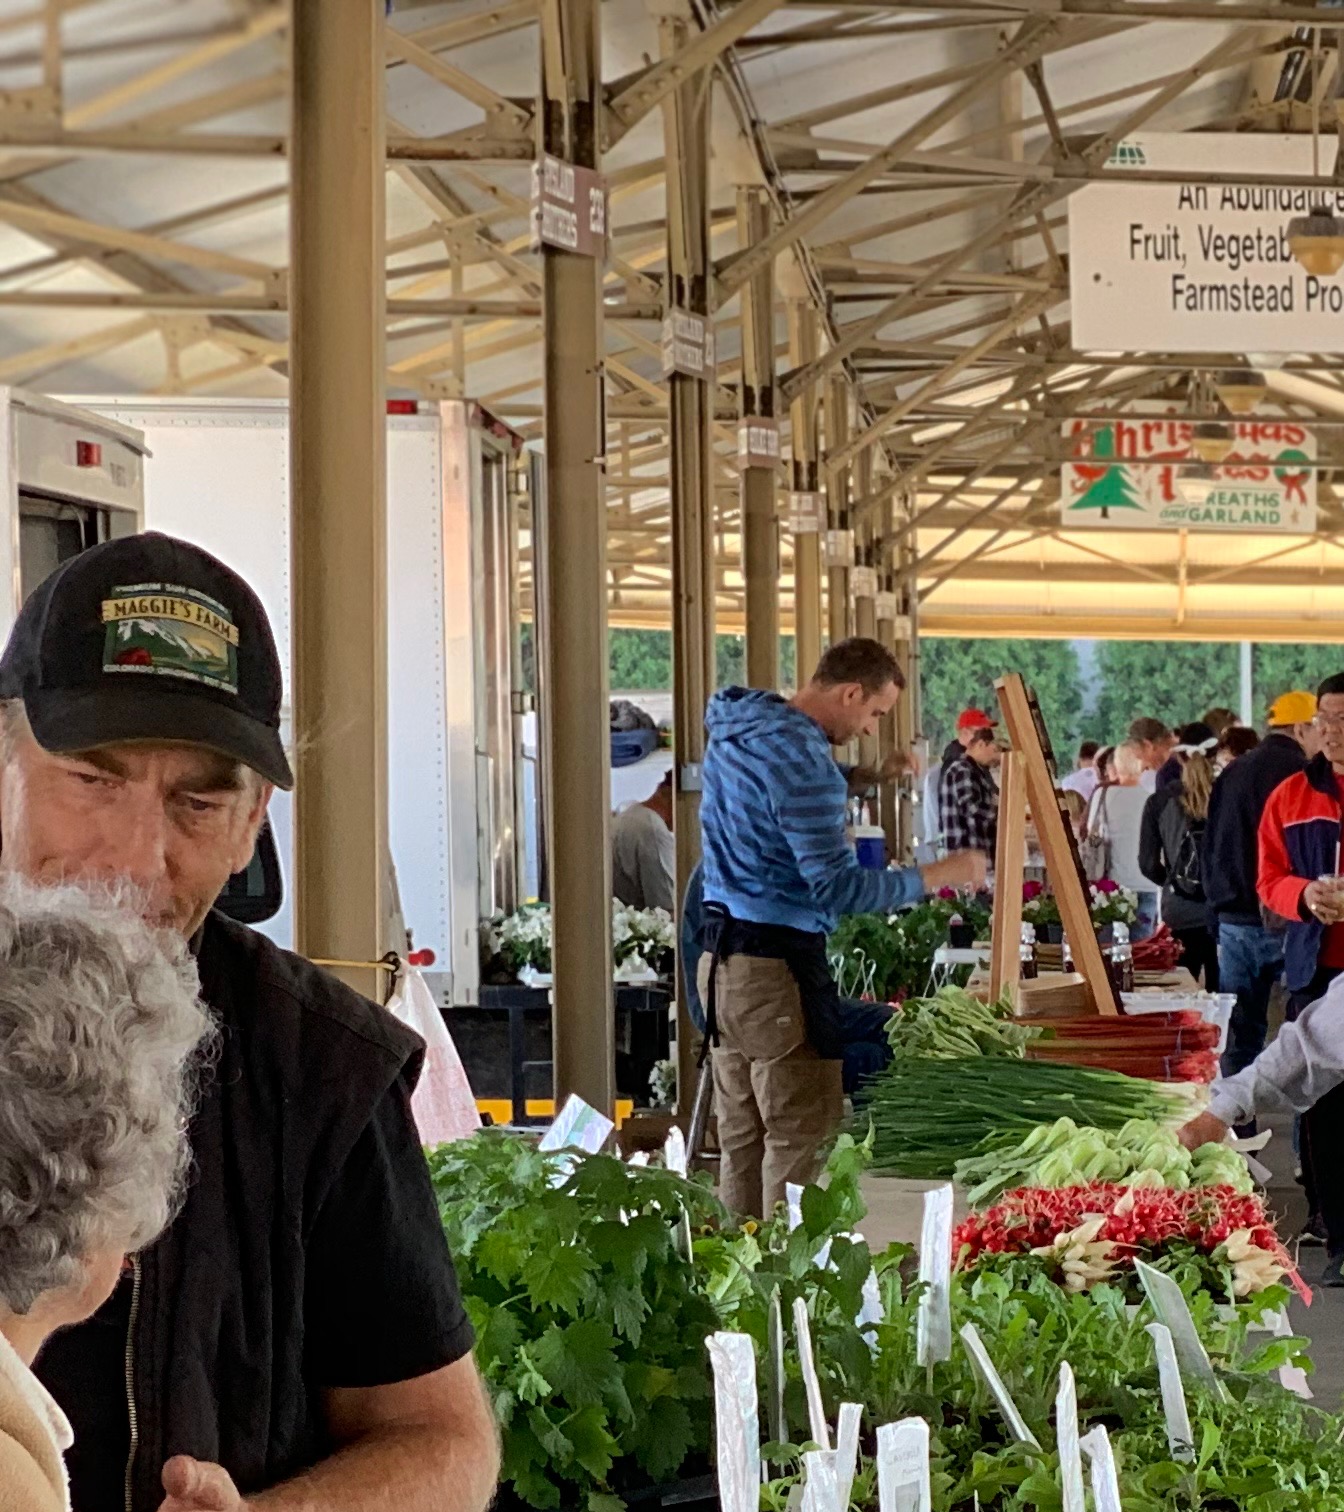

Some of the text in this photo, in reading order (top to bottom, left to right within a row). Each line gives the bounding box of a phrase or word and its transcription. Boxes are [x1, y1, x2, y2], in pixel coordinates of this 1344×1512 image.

[1129, 223, 1187, 267] Fruit,
[1197, 224, 1299, 271] Vegetab
[1171, 274, 1294, 313] Farmstead
[1188, 506, 1282, 525] GARLAND
[1205, 491, 1281, 509] REATHS
[114, 598, 192, 618] MAGGIE'S
[195, 606, 231, 639] FARM
